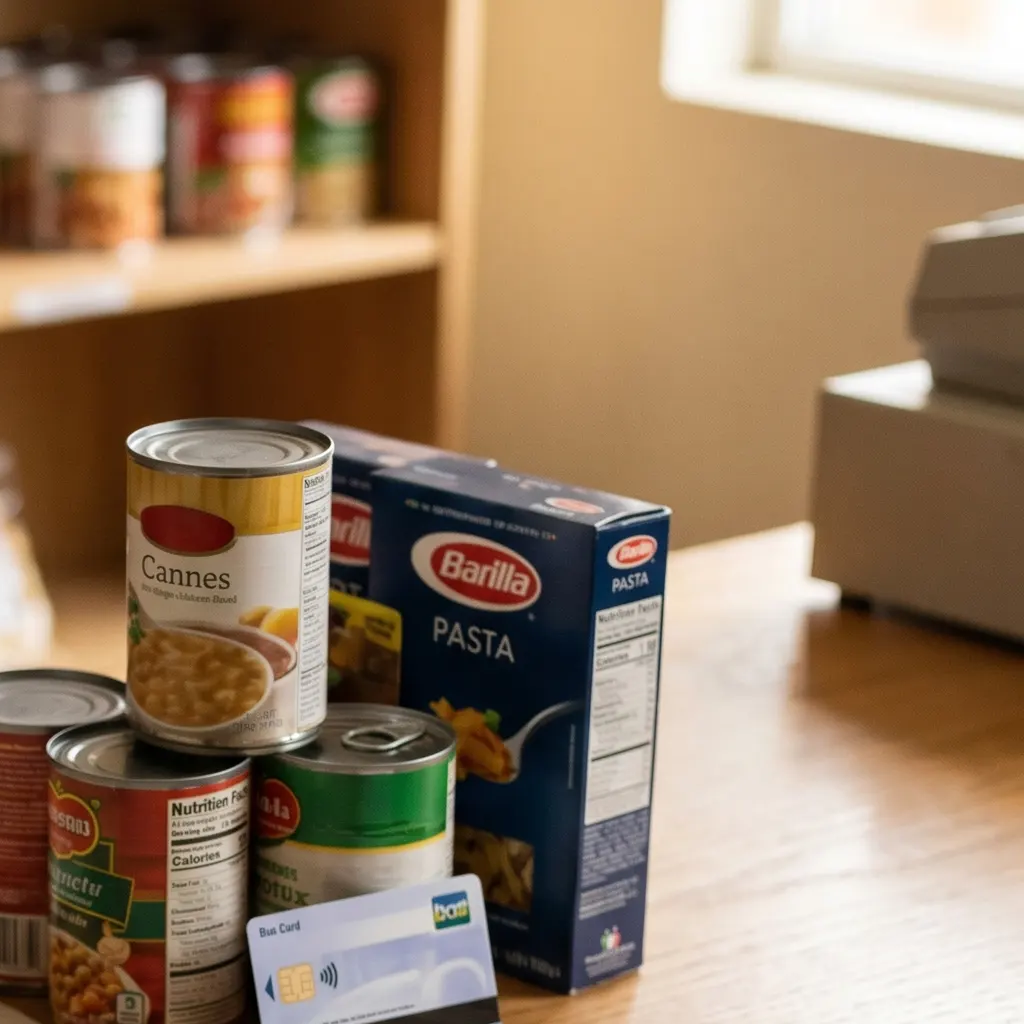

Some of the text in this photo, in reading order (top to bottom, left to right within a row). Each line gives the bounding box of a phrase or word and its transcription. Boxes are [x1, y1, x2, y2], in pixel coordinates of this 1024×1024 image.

[141, 554, 231, 590] Cannes
[439, 549, 531, 597] Barilla
[612, 571, 649, 592] PASTA
[433, 615, 515, 664] PASTA
